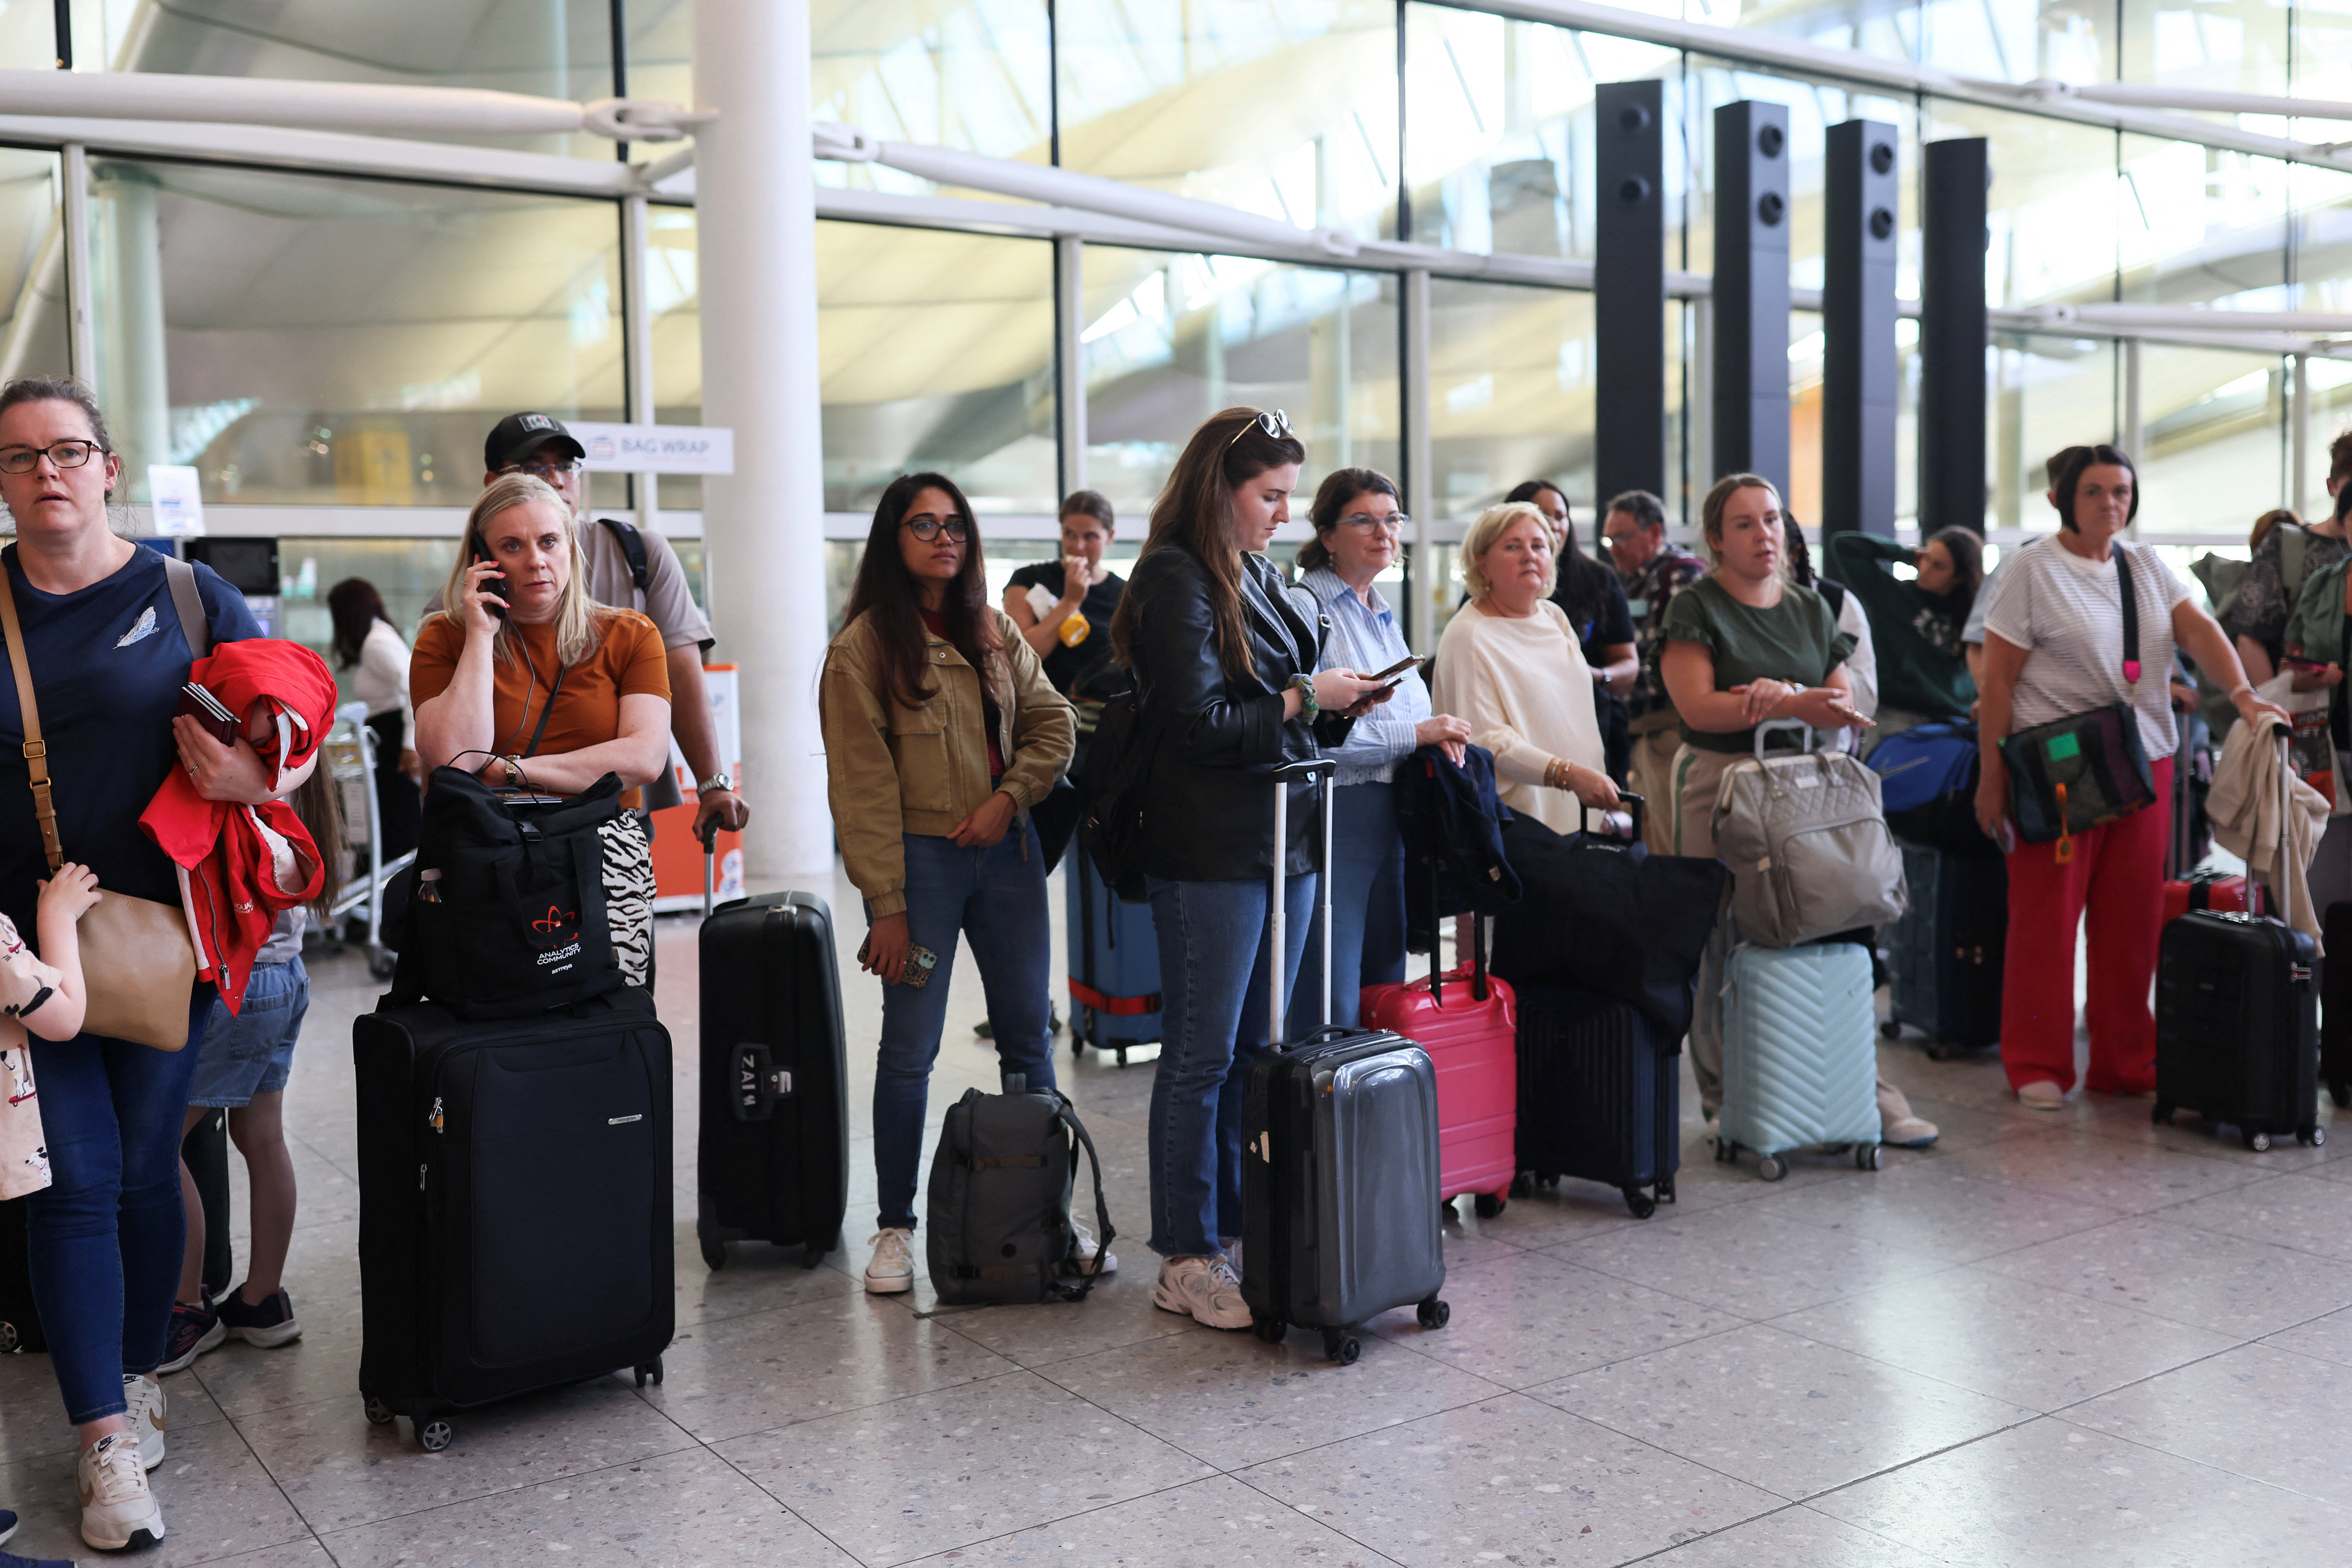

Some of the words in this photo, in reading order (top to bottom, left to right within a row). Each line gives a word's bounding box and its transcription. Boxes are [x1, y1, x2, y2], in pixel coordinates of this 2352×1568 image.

[621, 437, 658, 454] BAG
[660, 439, 710, 455] WRAP
[537, 947, 581, 965] COMMUNITY
[539, 943, 579, 959] ANALYTICS
[100, 1435, 113, 1447] NIKE
